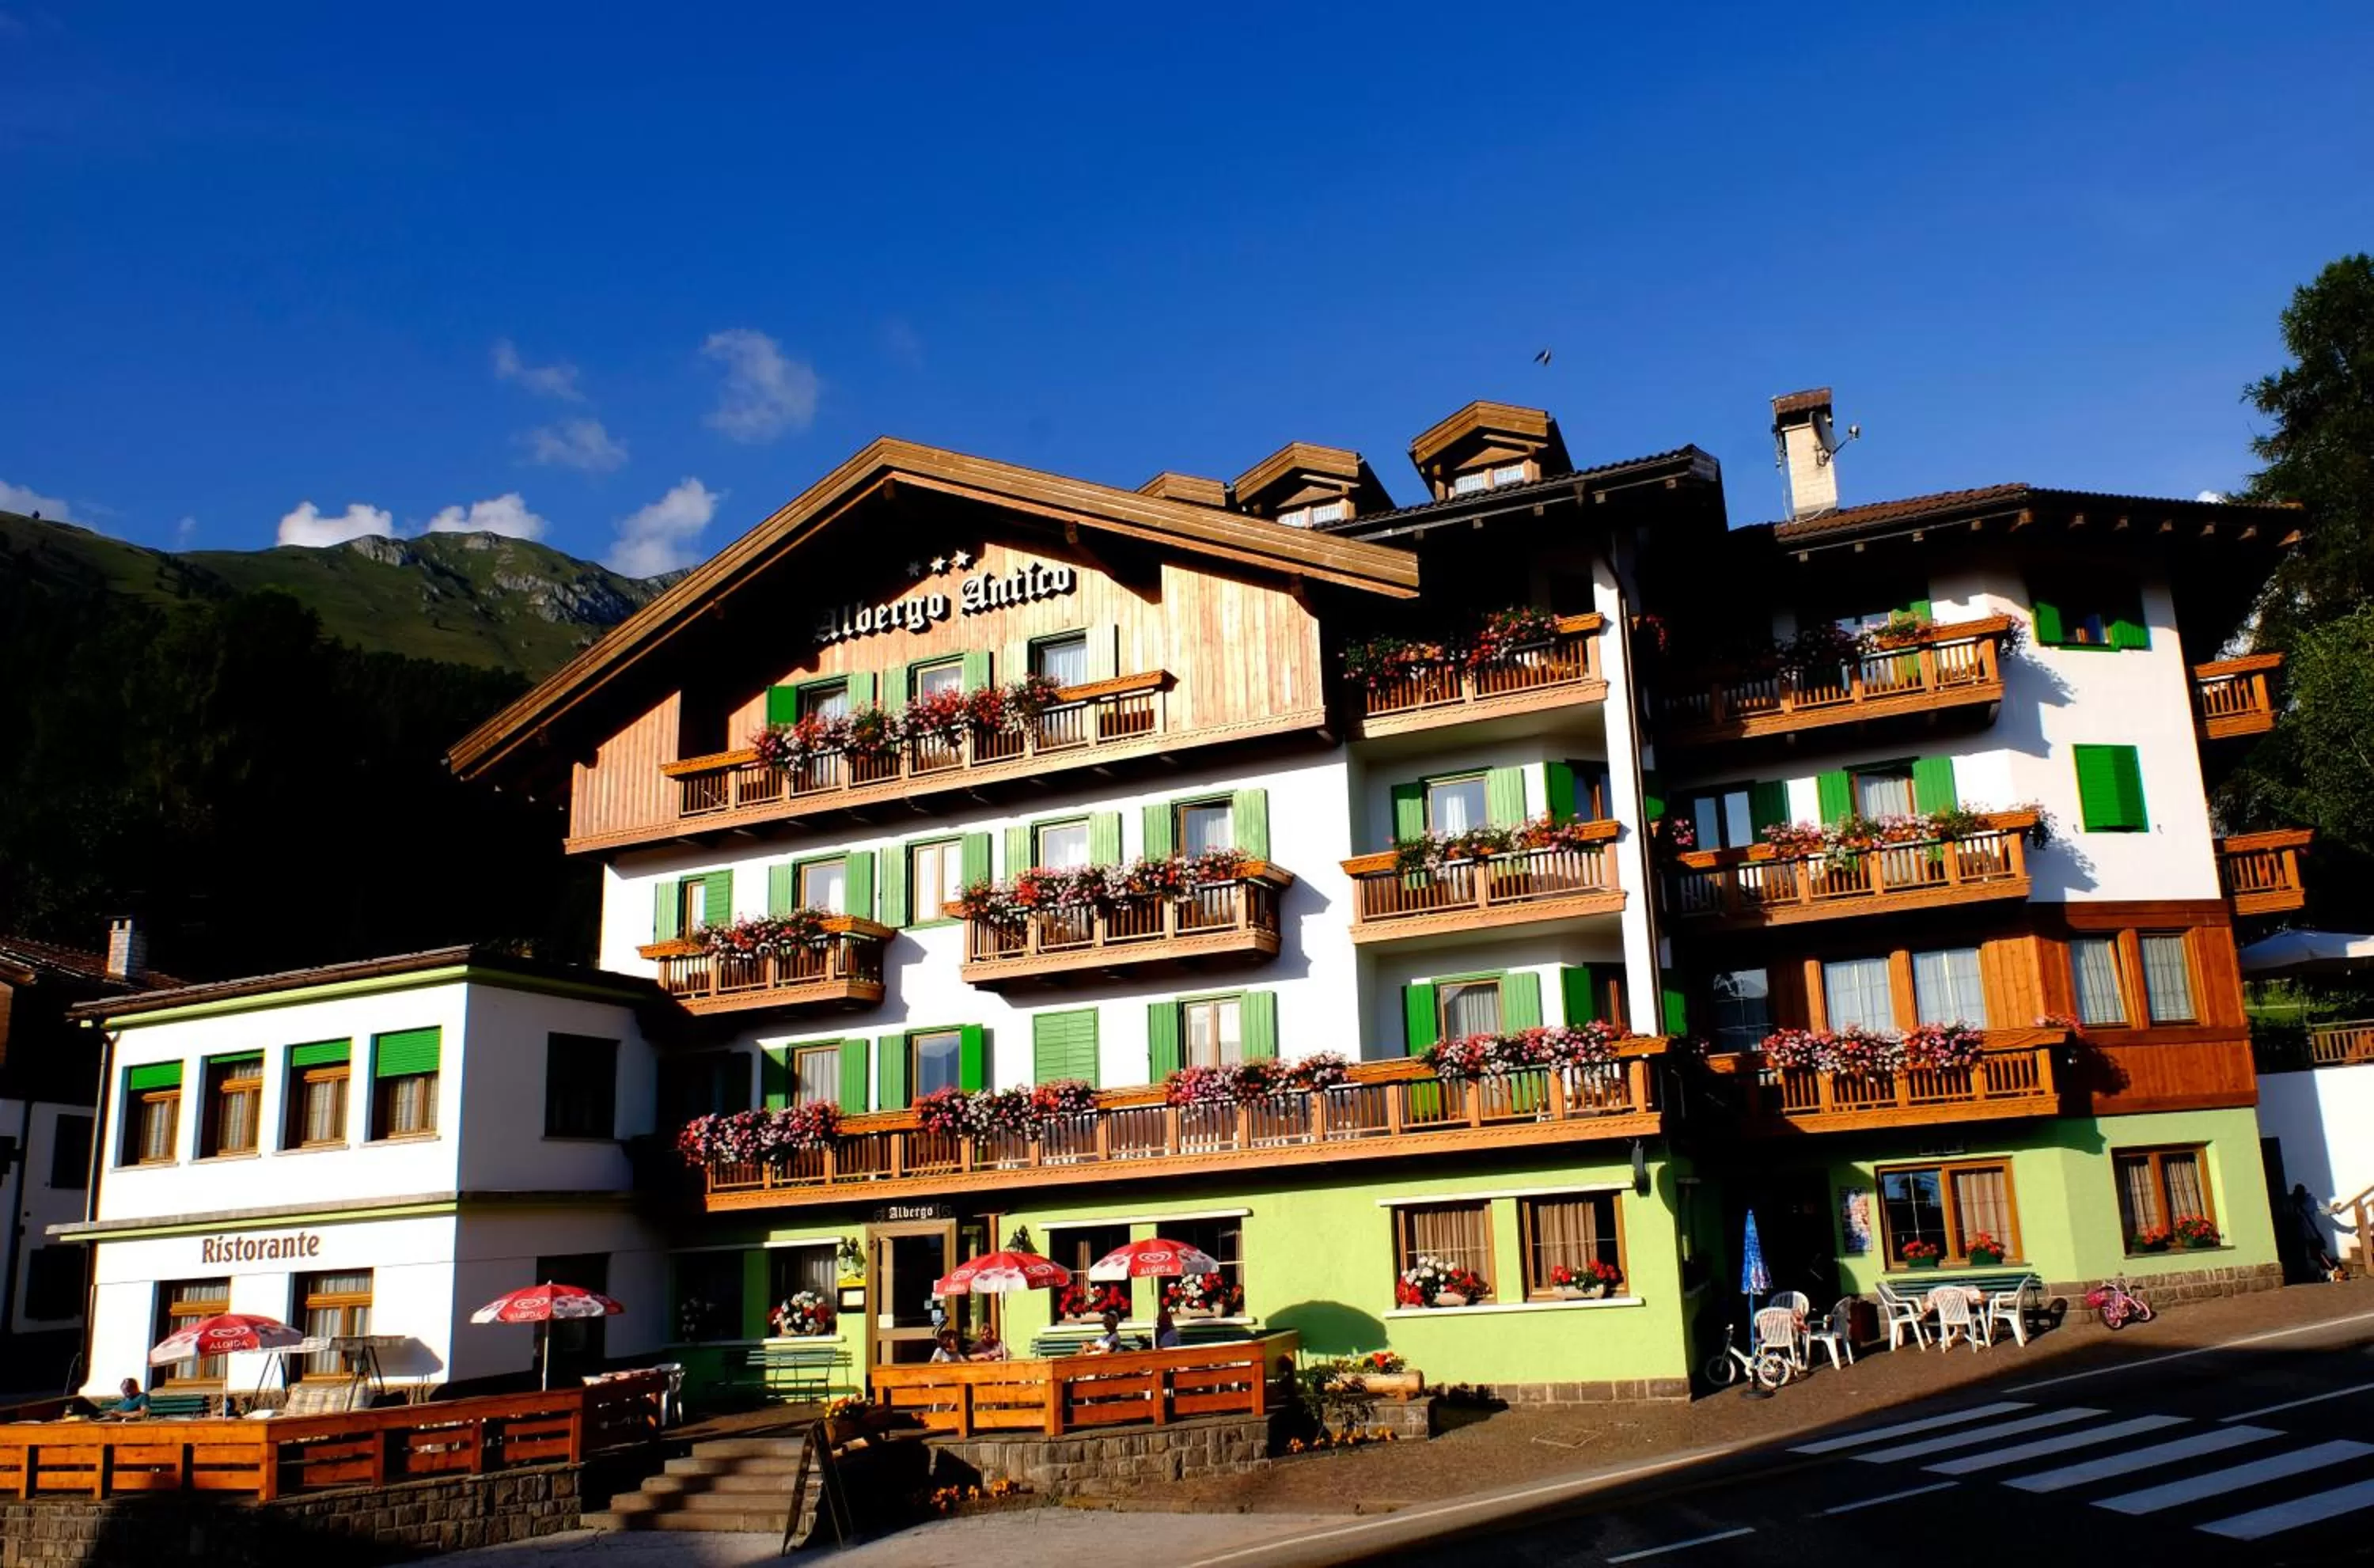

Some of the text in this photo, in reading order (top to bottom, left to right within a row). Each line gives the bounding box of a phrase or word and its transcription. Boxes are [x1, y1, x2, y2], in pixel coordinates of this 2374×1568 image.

[811, 565, 1072, 644] Albergo Antico
[889, 1206, 933, 1219] Albergo
[202, 1231, 320, 1264] Ristorante
